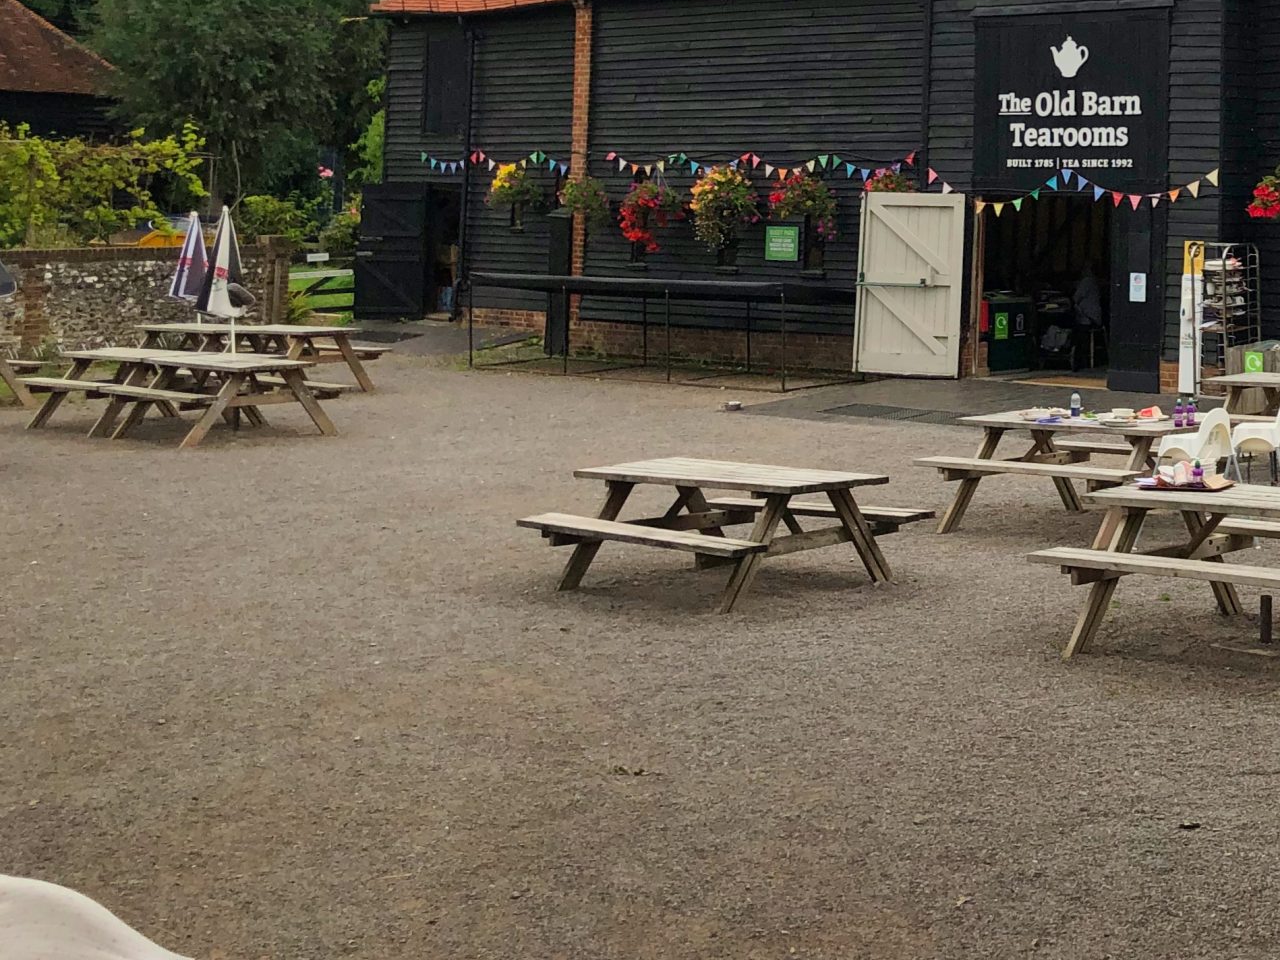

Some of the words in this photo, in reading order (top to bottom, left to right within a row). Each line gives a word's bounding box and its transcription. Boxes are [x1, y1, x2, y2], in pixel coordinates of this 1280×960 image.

[998, 93, 1032, 114] The
[1035, 90, 1076, 116] Old
[1081, 91, 1142, 115] Barn
[1010, 123, 1129, 147] Tearooms
[1006, 158, 1032, 168] BUILT
[1034, 158, 1054, 168] 1785
[1062, 158, 1080, 168] TEA
[1081, 158, 1109, 168] SINCE
[1111, 158, 1133, 168] 1992
